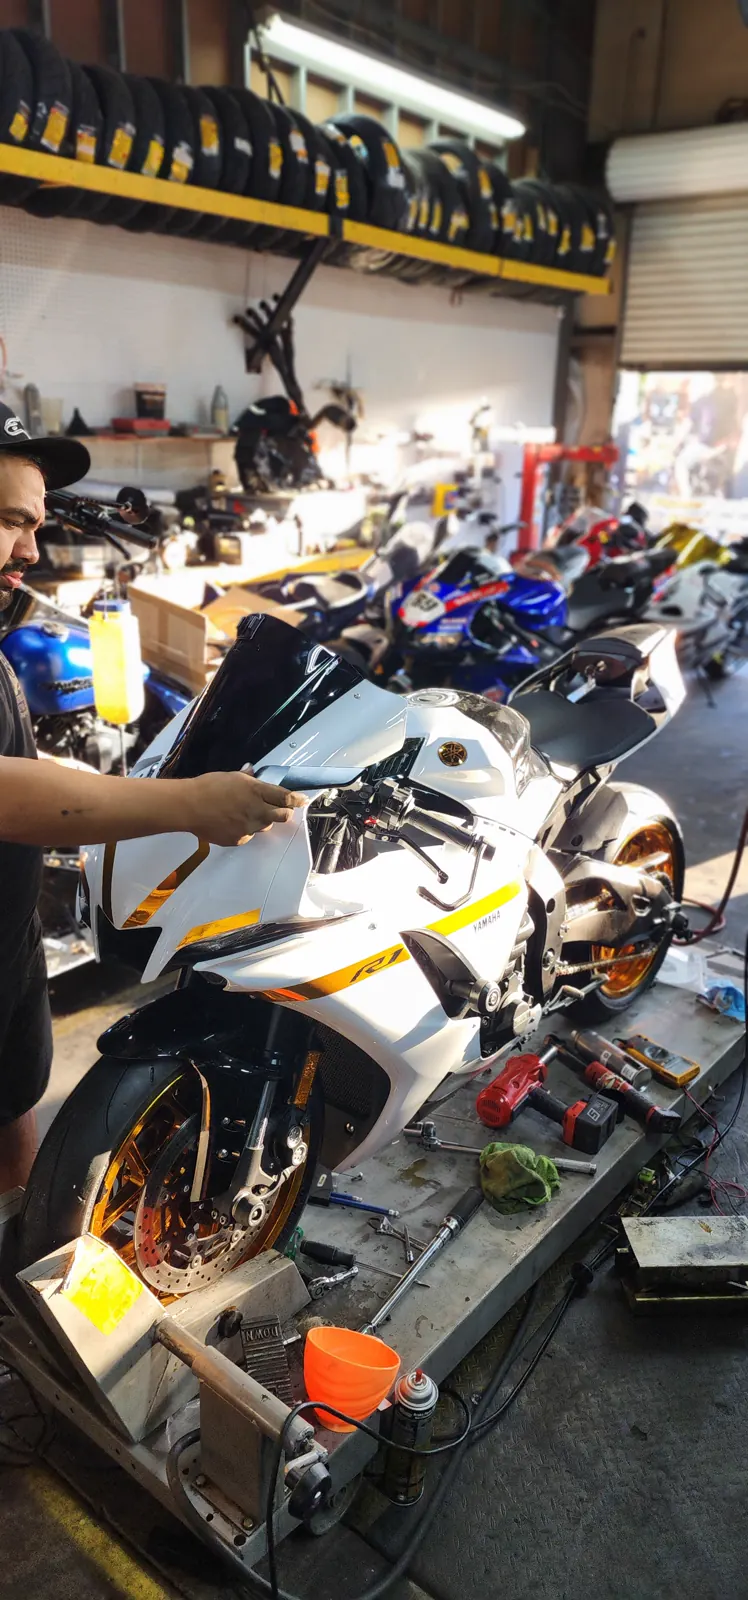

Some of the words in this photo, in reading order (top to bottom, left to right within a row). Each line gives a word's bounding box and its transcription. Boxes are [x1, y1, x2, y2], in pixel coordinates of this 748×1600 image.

[473, 910, 501, 934] YAMAHA
[349, 947, 404, 984] R1
[246, 1326, 279, 1342] DOWN
